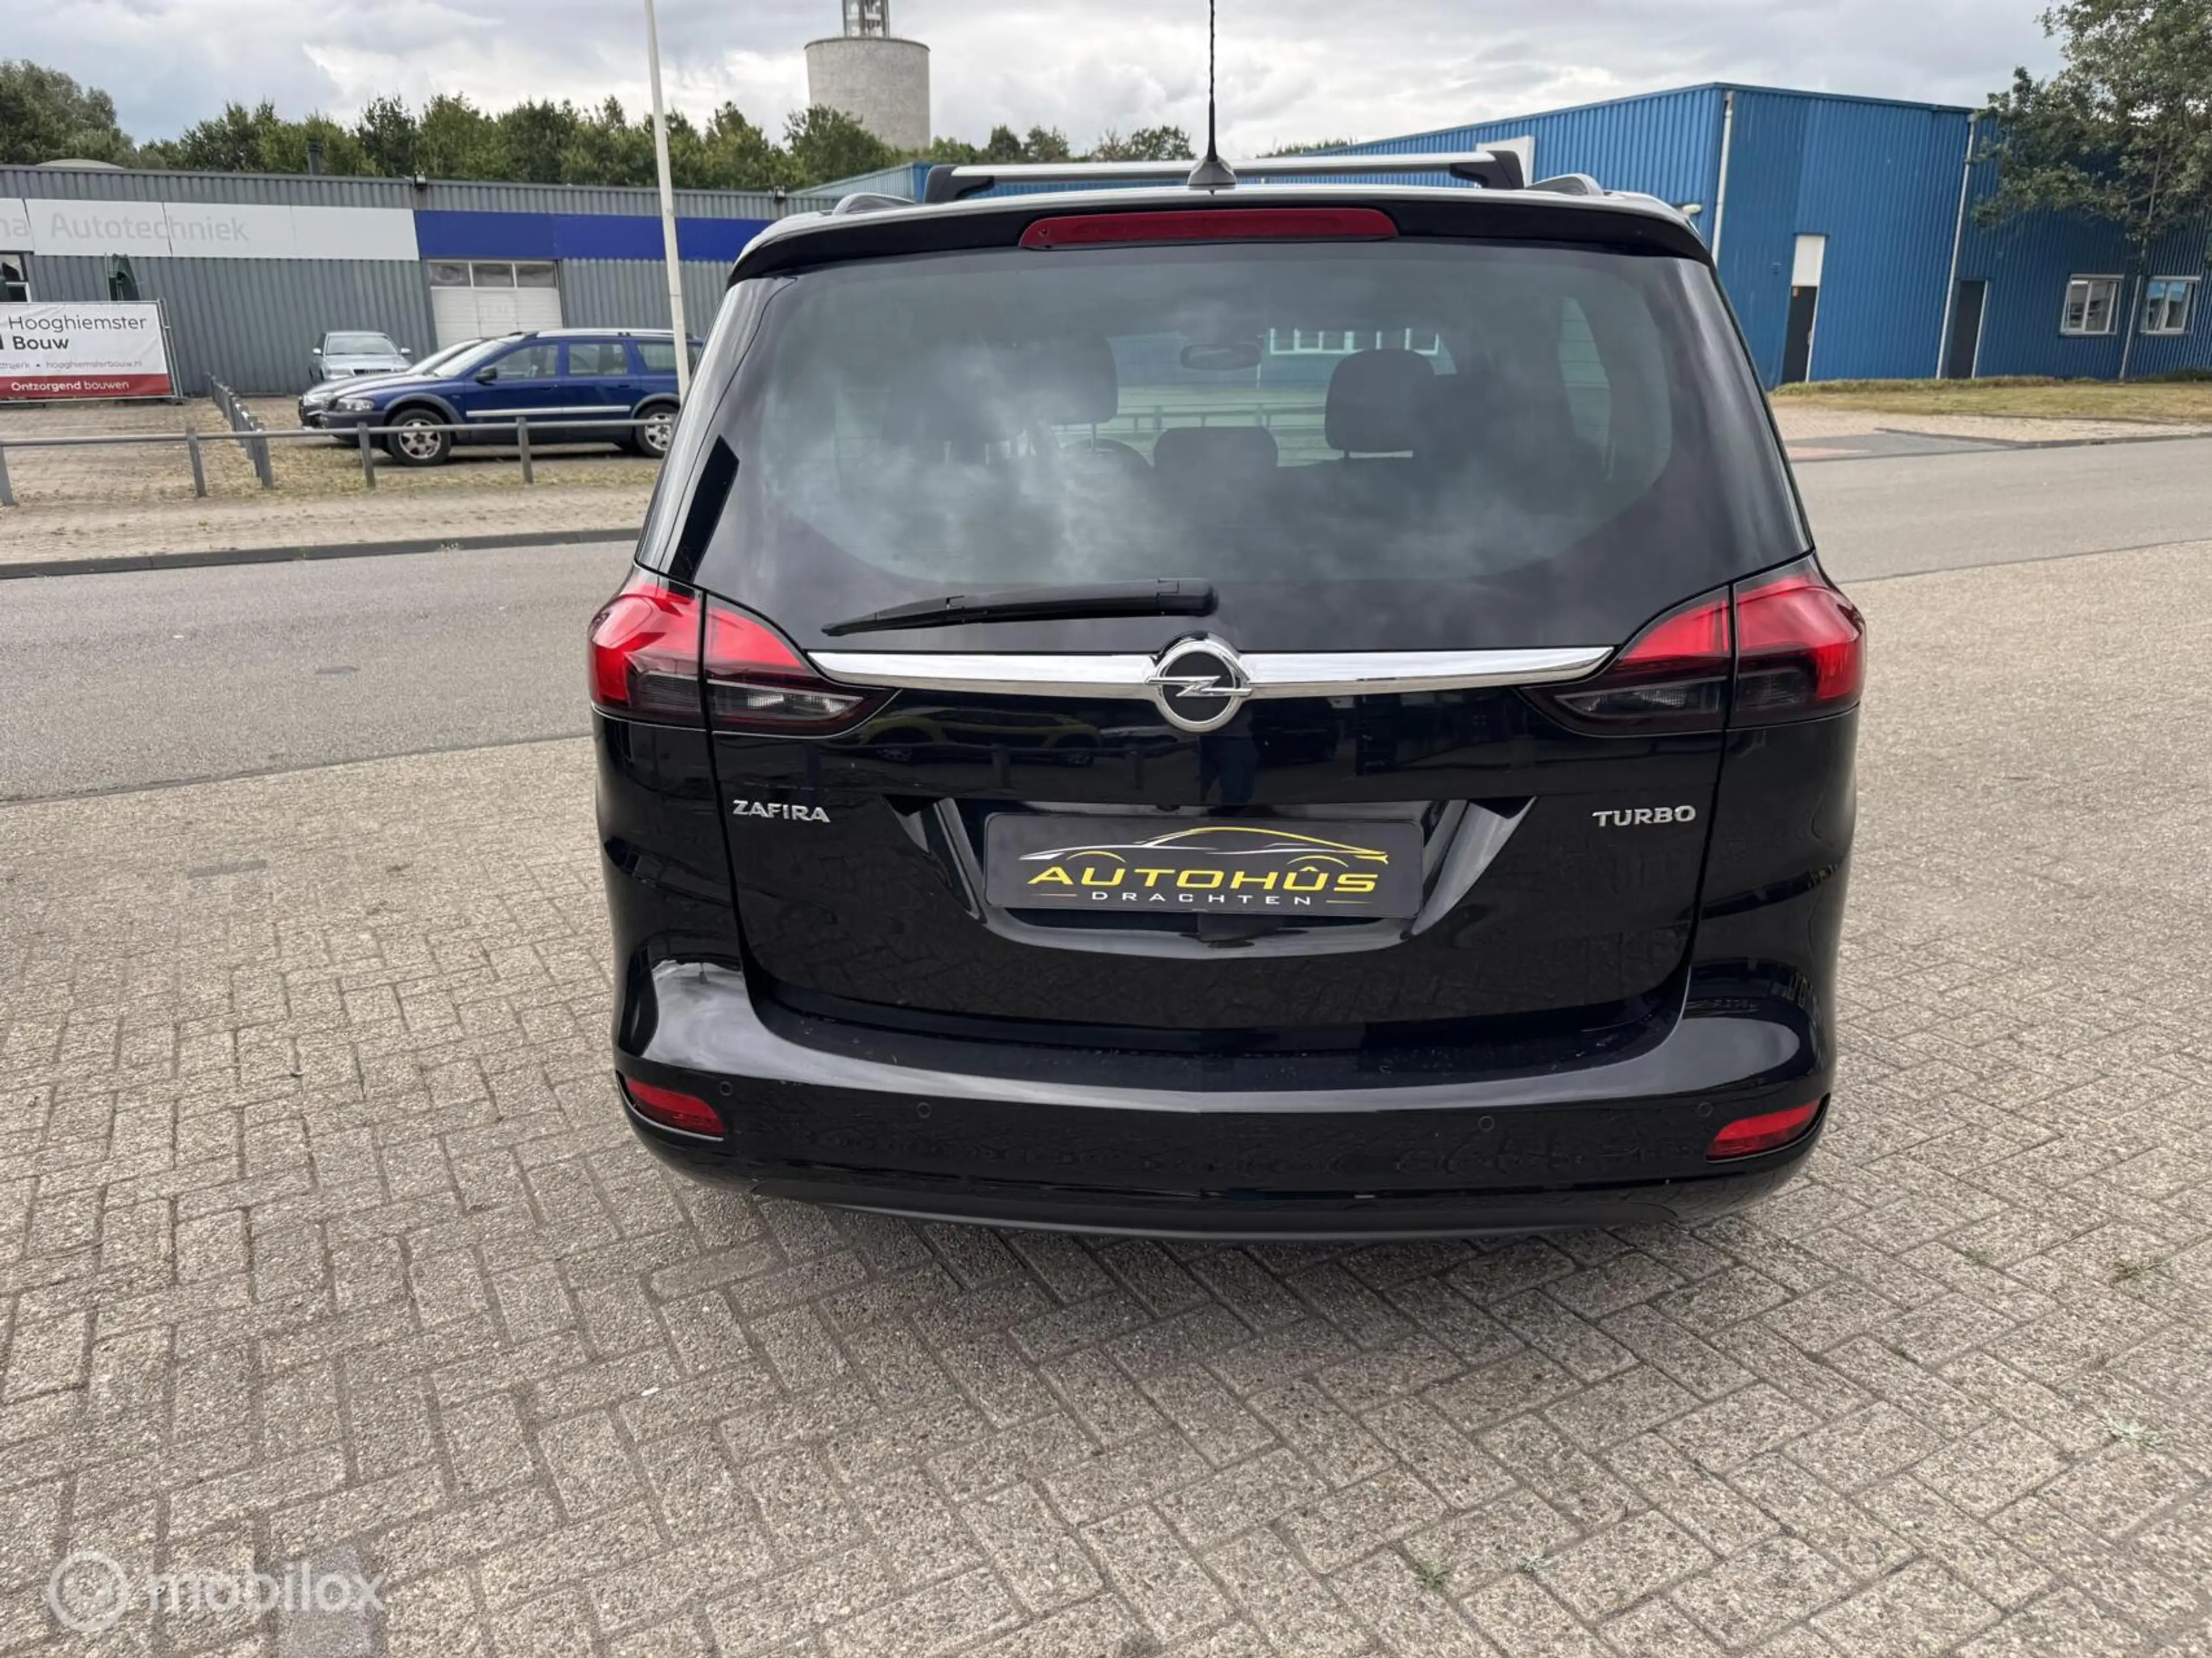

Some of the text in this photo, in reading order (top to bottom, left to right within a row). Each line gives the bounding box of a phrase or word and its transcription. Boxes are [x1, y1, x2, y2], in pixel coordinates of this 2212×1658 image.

[51, 213, 251, 242] Autotechniek
[8, 314, 147, 332] Hooghiemster
[12, 336, 69, 350] Bouw
[10, 380, 130, 392] Ontzorgend bouwen
[732, 799, 830, 824] ZAFIRA
[1592, 805, 1696, 828] TURBO
[1027, 866, 1378, 893] AUTOHÛS
[1092, 891, 1311, 906] DRACHTEN
